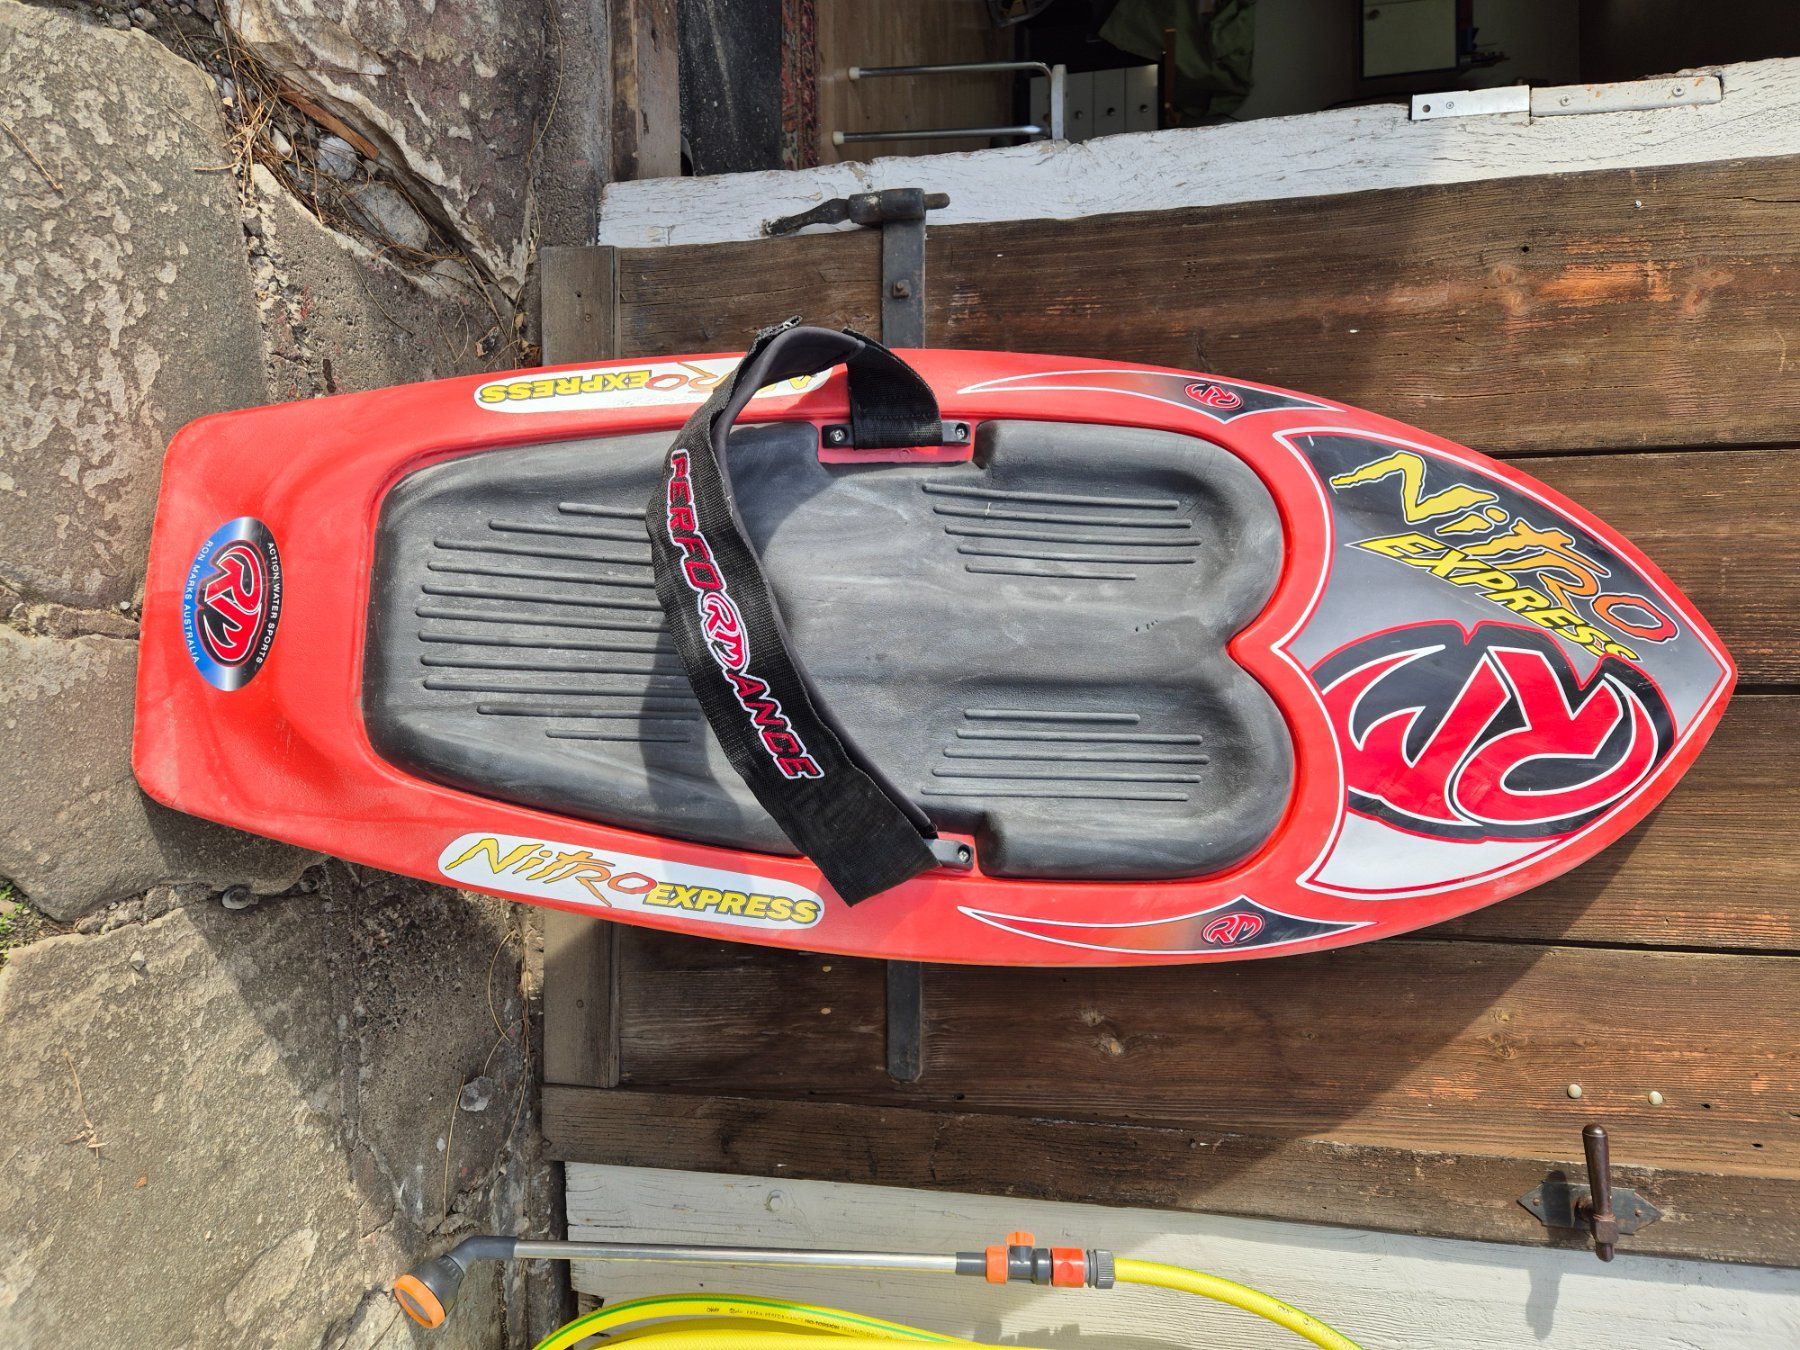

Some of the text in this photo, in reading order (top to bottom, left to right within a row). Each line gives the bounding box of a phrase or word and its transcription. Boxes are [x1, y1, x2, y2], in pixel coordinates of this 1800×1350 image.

[479, 369, 652, 403] EXPRESS
[183, 540, 214, 665] RON MARKS AUSTRALIA
[256, 542, 281, 665] ACTION WATER SPORTS
[1344, 532, 1642, 662] EXPRESS
[642, 881, 821, 924] EXPRESS
[1203, 914, 1262, 943] RM
